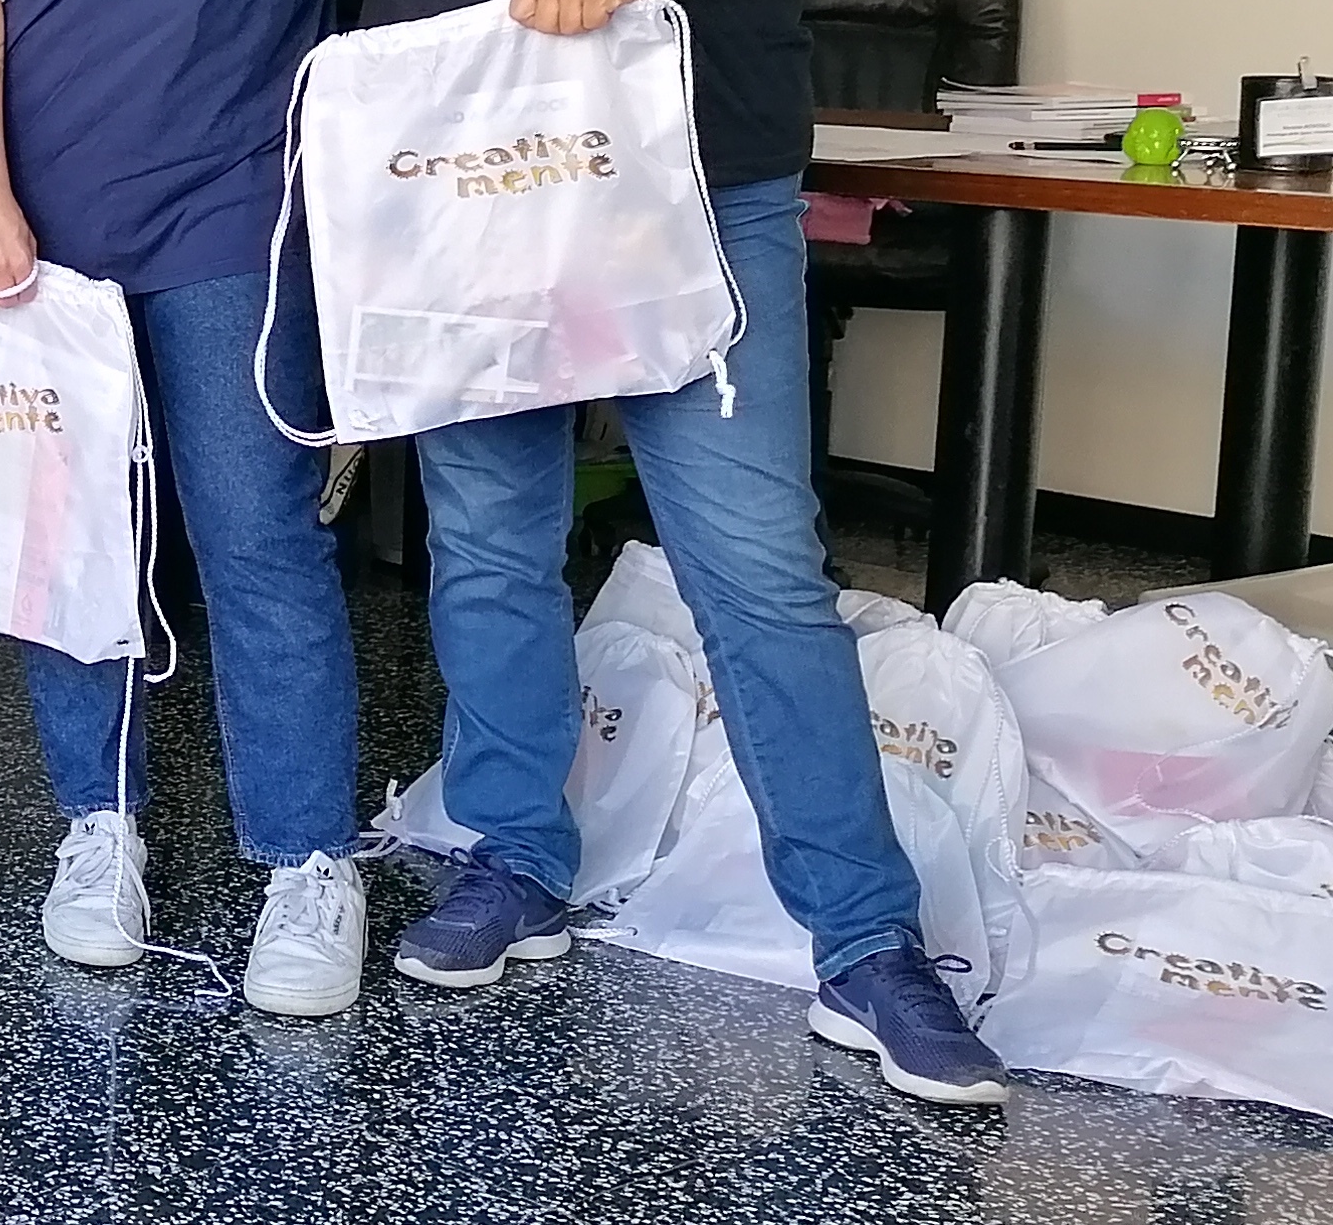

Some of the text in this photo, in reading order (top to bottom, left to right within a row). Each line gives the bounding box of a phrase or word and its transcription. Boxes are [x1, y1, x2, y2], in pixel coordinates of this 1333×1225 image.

[386, 129, 613, 180] Creativa
[456, 152, 620, 199] mente
[1093, 931, 1327, 997] Creativa
[1159, 968, 1328, 1012] mente
